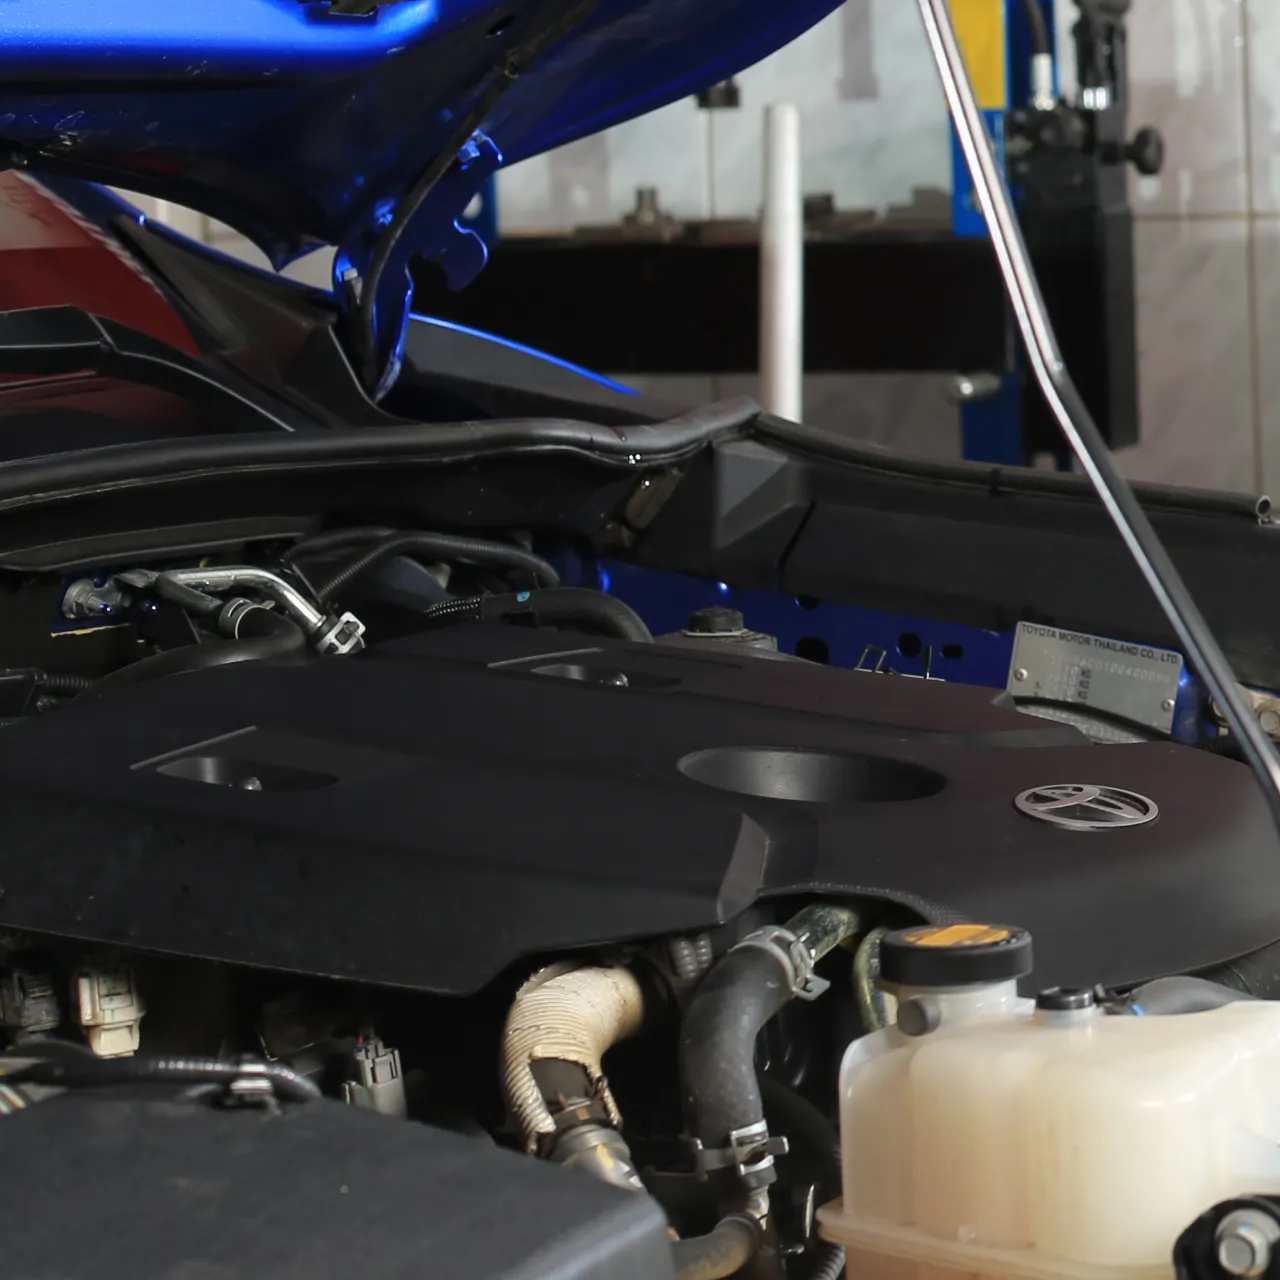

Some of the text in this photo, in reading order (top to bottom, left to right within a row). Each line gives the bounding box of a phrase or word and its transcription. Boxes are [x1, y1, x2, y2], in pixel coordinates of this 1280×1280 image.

[1021, 623, 1057, 640] TOYOTA
[1057, 631, 1092, 647] MOTOR
[1093, 637, 1139, 657] THAILAND
